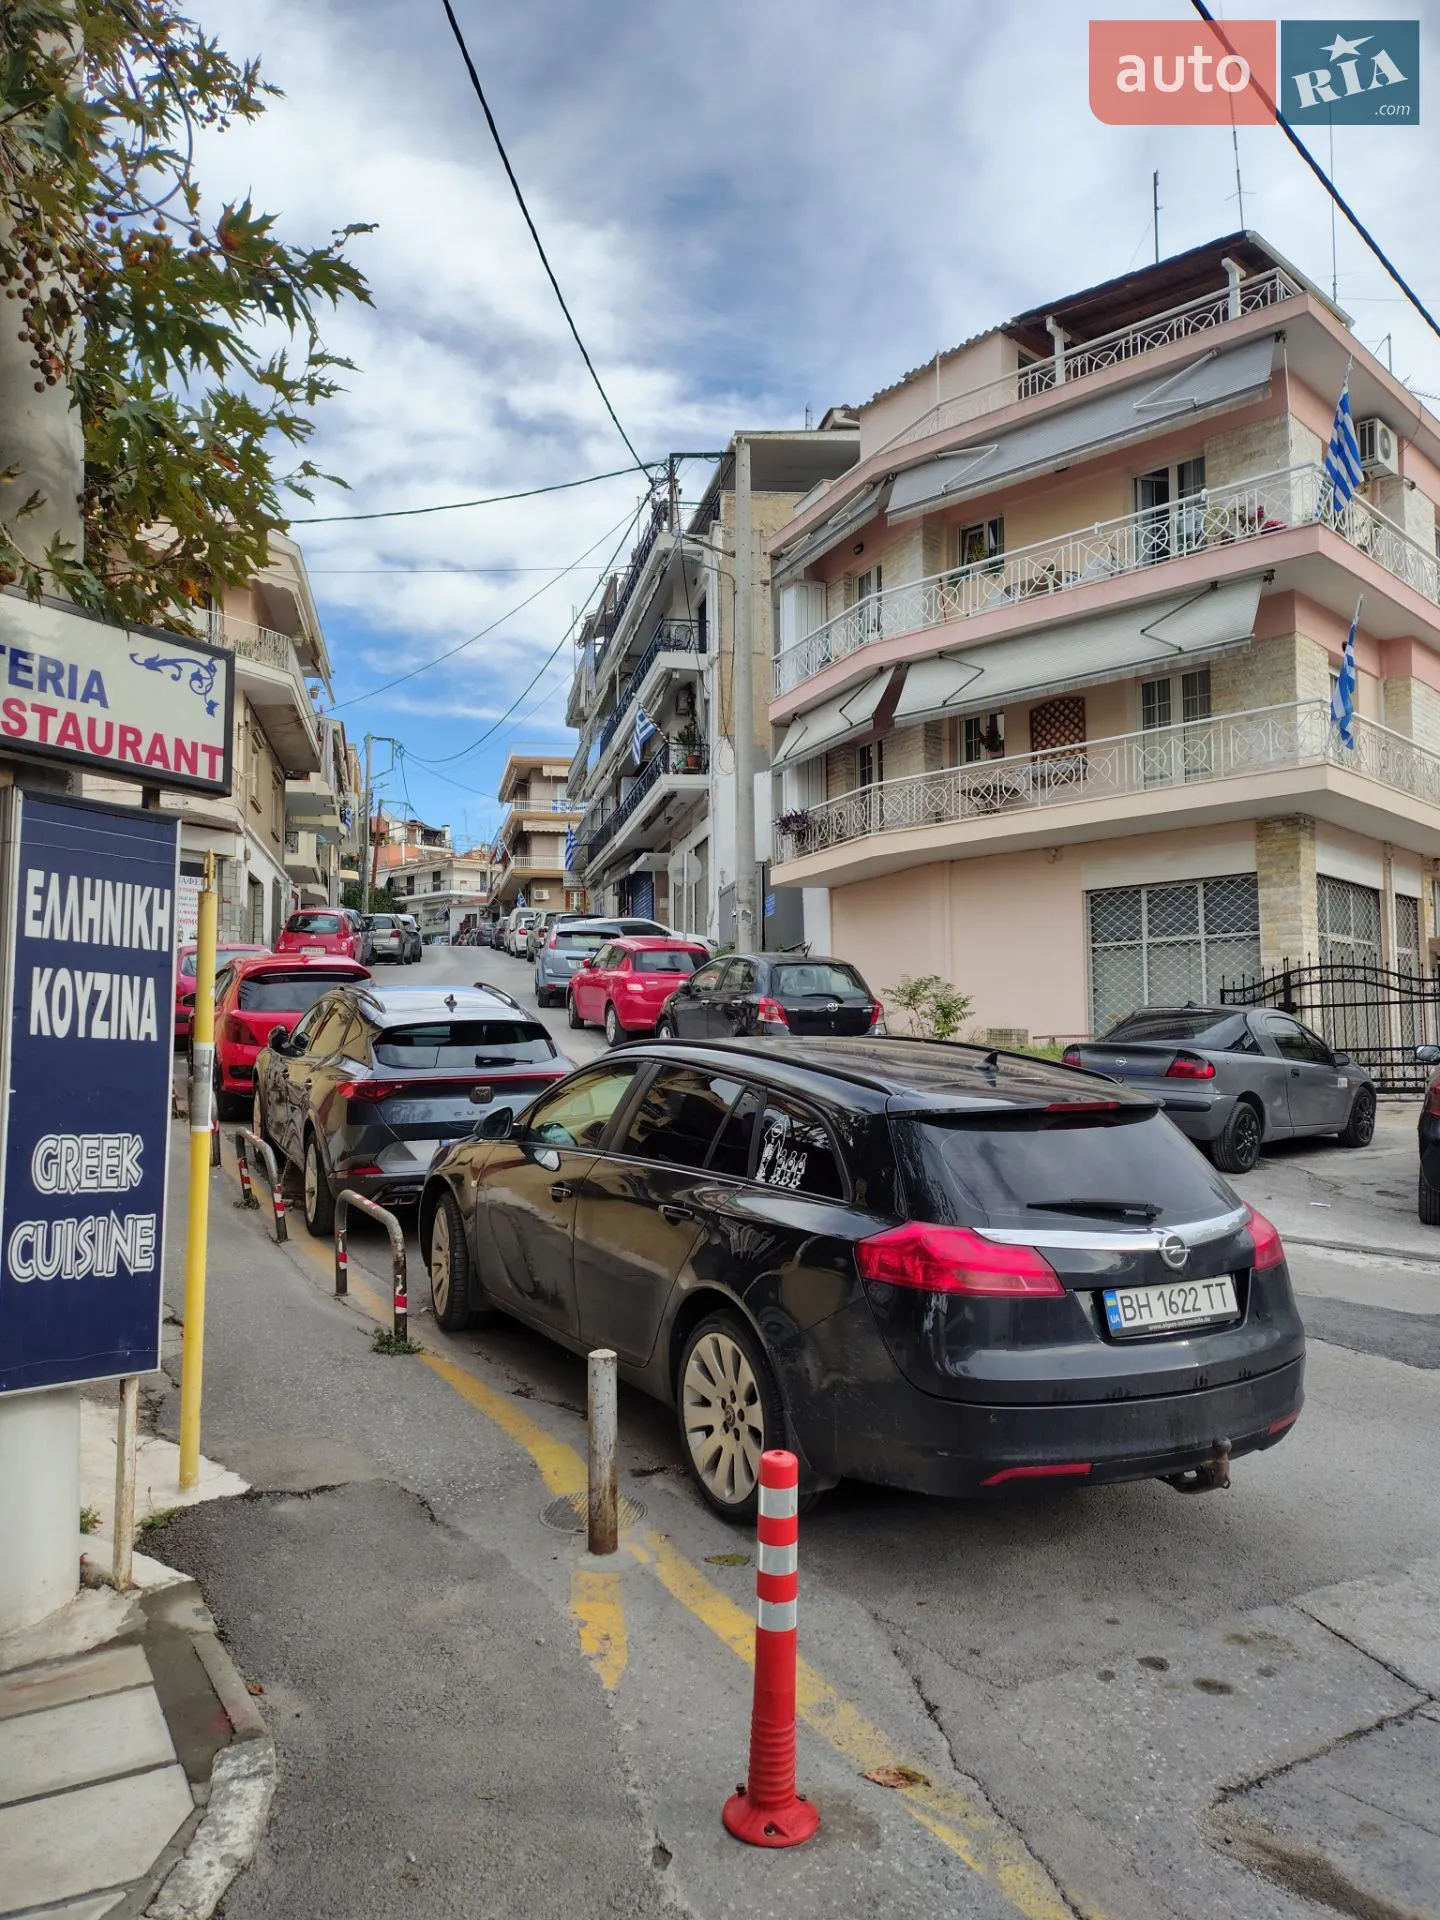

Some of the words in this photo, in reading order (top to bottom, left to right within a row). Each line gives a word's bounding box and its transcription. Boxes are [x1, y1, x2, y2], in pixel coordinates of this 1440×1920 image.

[24, 868, 172, 952] ΕΛΛΗΝΙΚΗ
[29, 966, 158, 1042] ΚΟΥΖΙΝΑ
[31, 1133, 144, 1195] GREEK
[7, 1209, 157, 1283] CUISINE
[1110, 1314, 1120, 1324] UA
[1120, 1292, 1153, 1321] BH
[1157, 1287, 1201, 1316] 1622
[1202, 1283, 1226, 1309] TT
